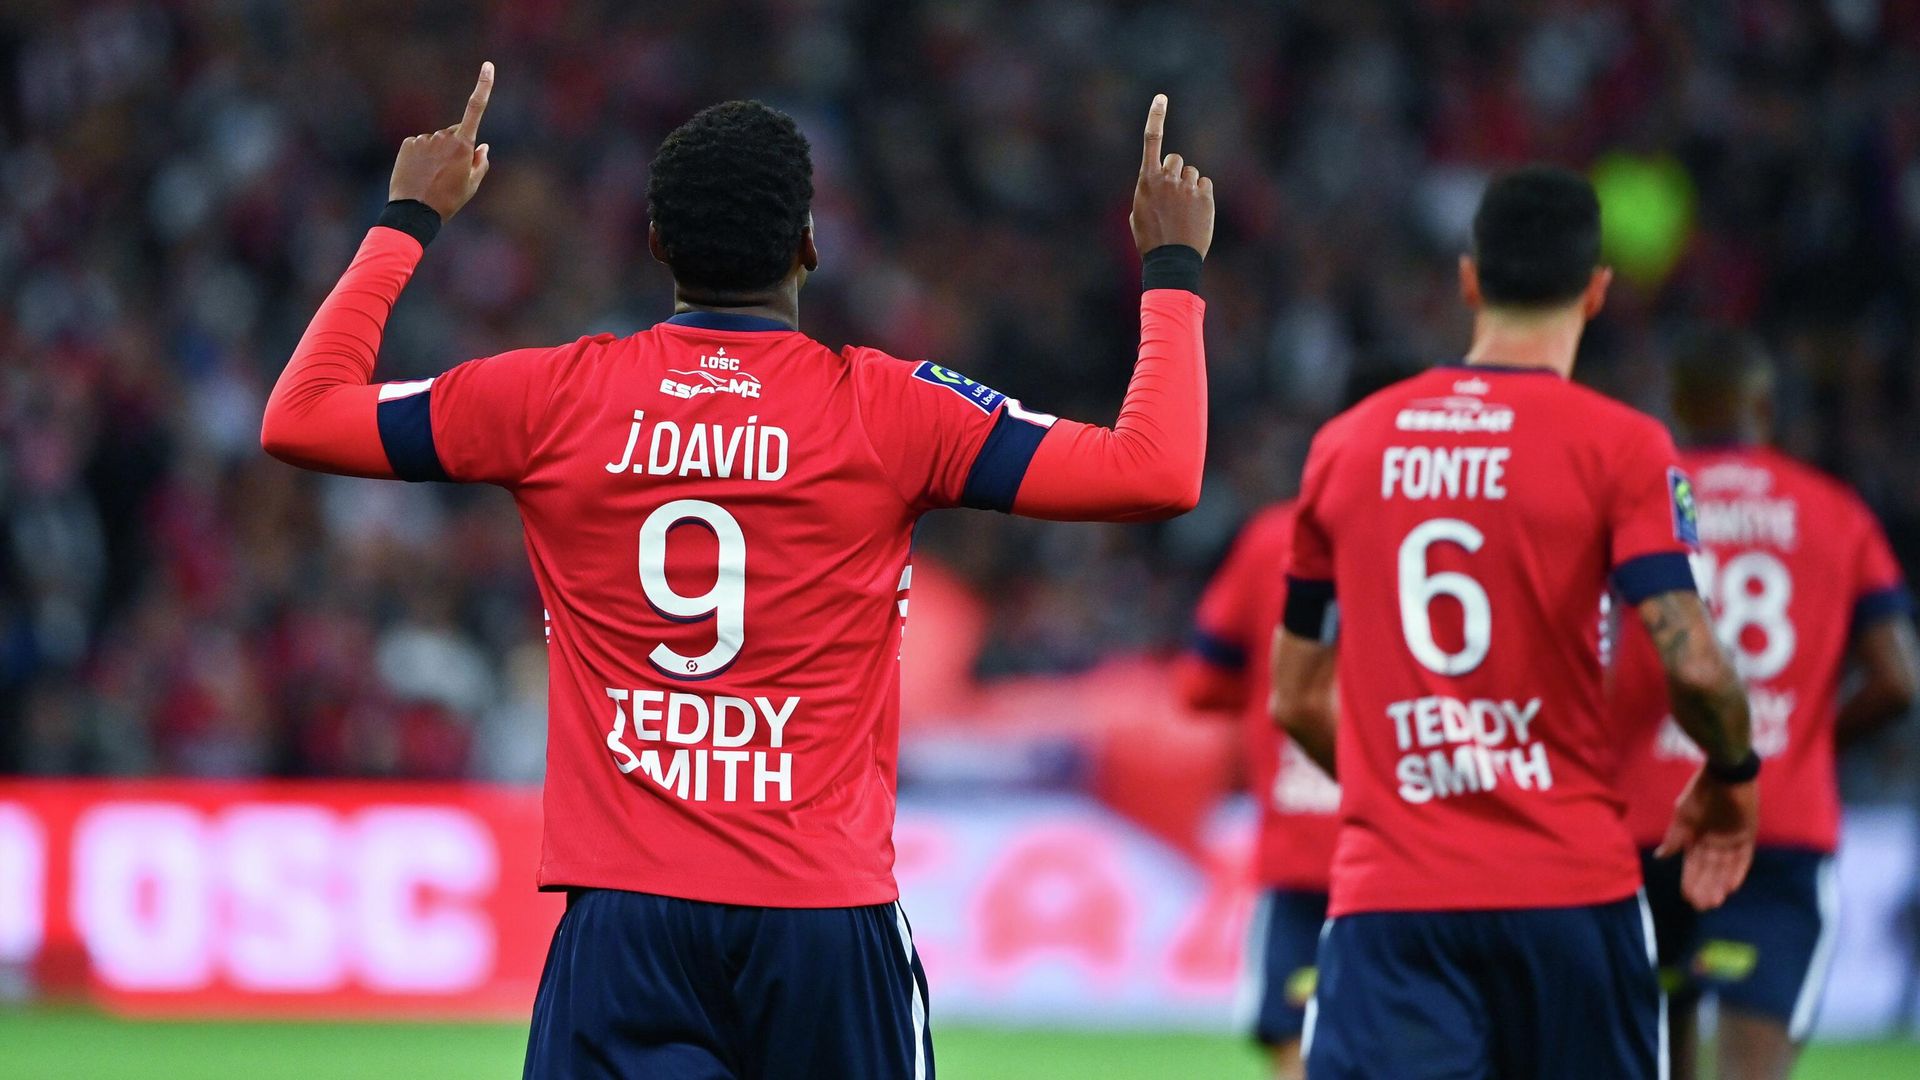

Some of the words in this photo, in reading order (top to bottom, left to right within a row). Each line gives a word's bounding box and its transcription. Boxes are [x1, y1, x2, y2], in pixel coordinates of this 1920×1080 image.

[699, 355, 740, 371] LOSC
[604, 409, 789, 481] J.DAVID
[1381, 446, 1512, 500] FONTE
[638, 499, 746, 681] 9
[1397, 517, 1492, 676] 6
[605, 687, 801, 749] TEDDY
[1385, 696, 1541, 750] TEDDY
[606, 730, 793, 802] SMITH
